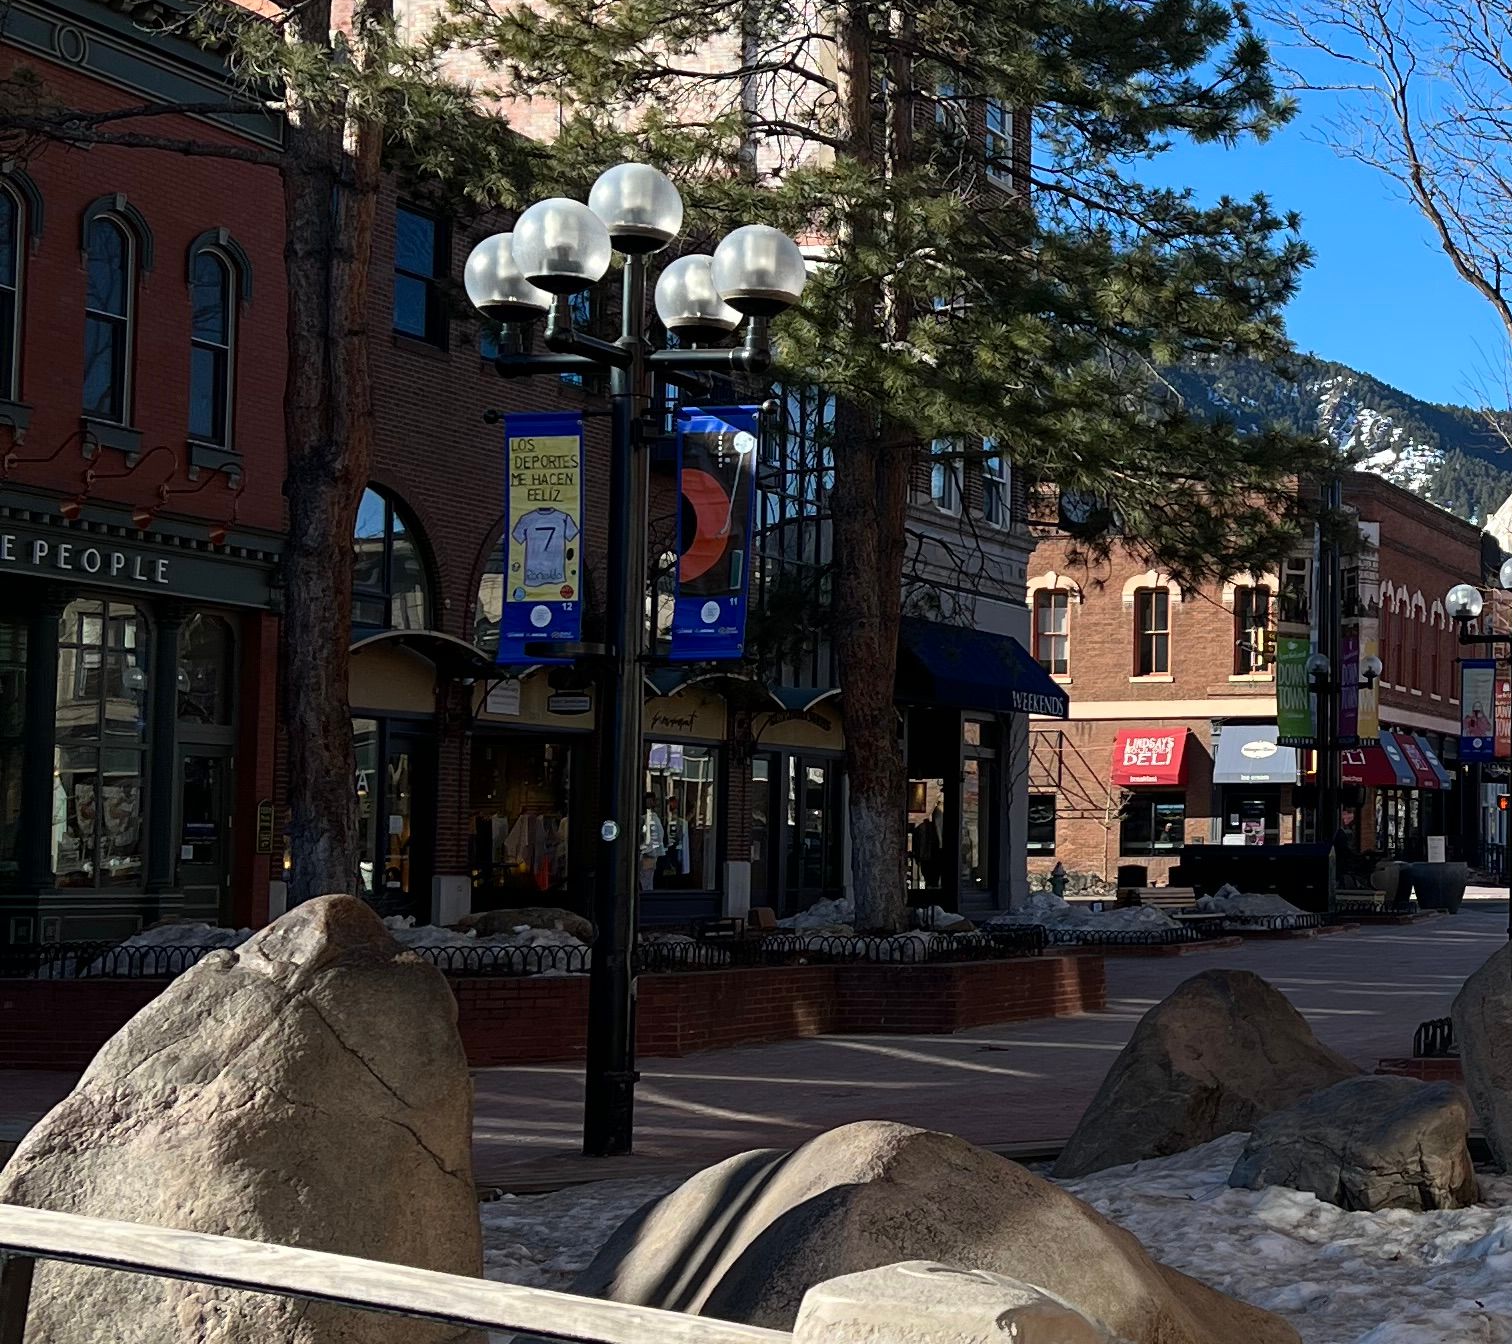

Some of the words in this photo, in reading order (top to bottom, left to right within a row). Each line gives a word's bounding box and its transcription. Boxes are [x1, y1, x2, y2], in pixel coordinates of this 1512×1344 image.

[511, 438, 537, 453] LOS
[514, 454, 579, 470] DEPORTES
[510, 472, 528, 487] ME
[531, 472, 574, 486] HACEN
[535, 526, 556, 552] 7
[32, 539, 169, 584] PEOPLE
[562, 602, 573, 611] 12
[729, 597, 738, 606] 11
[1012, 690, 1064, 716] WEEKENDS
[1279, 686, 1309, 709] TOWN
[1122, 752, 1172, 766] DELI
